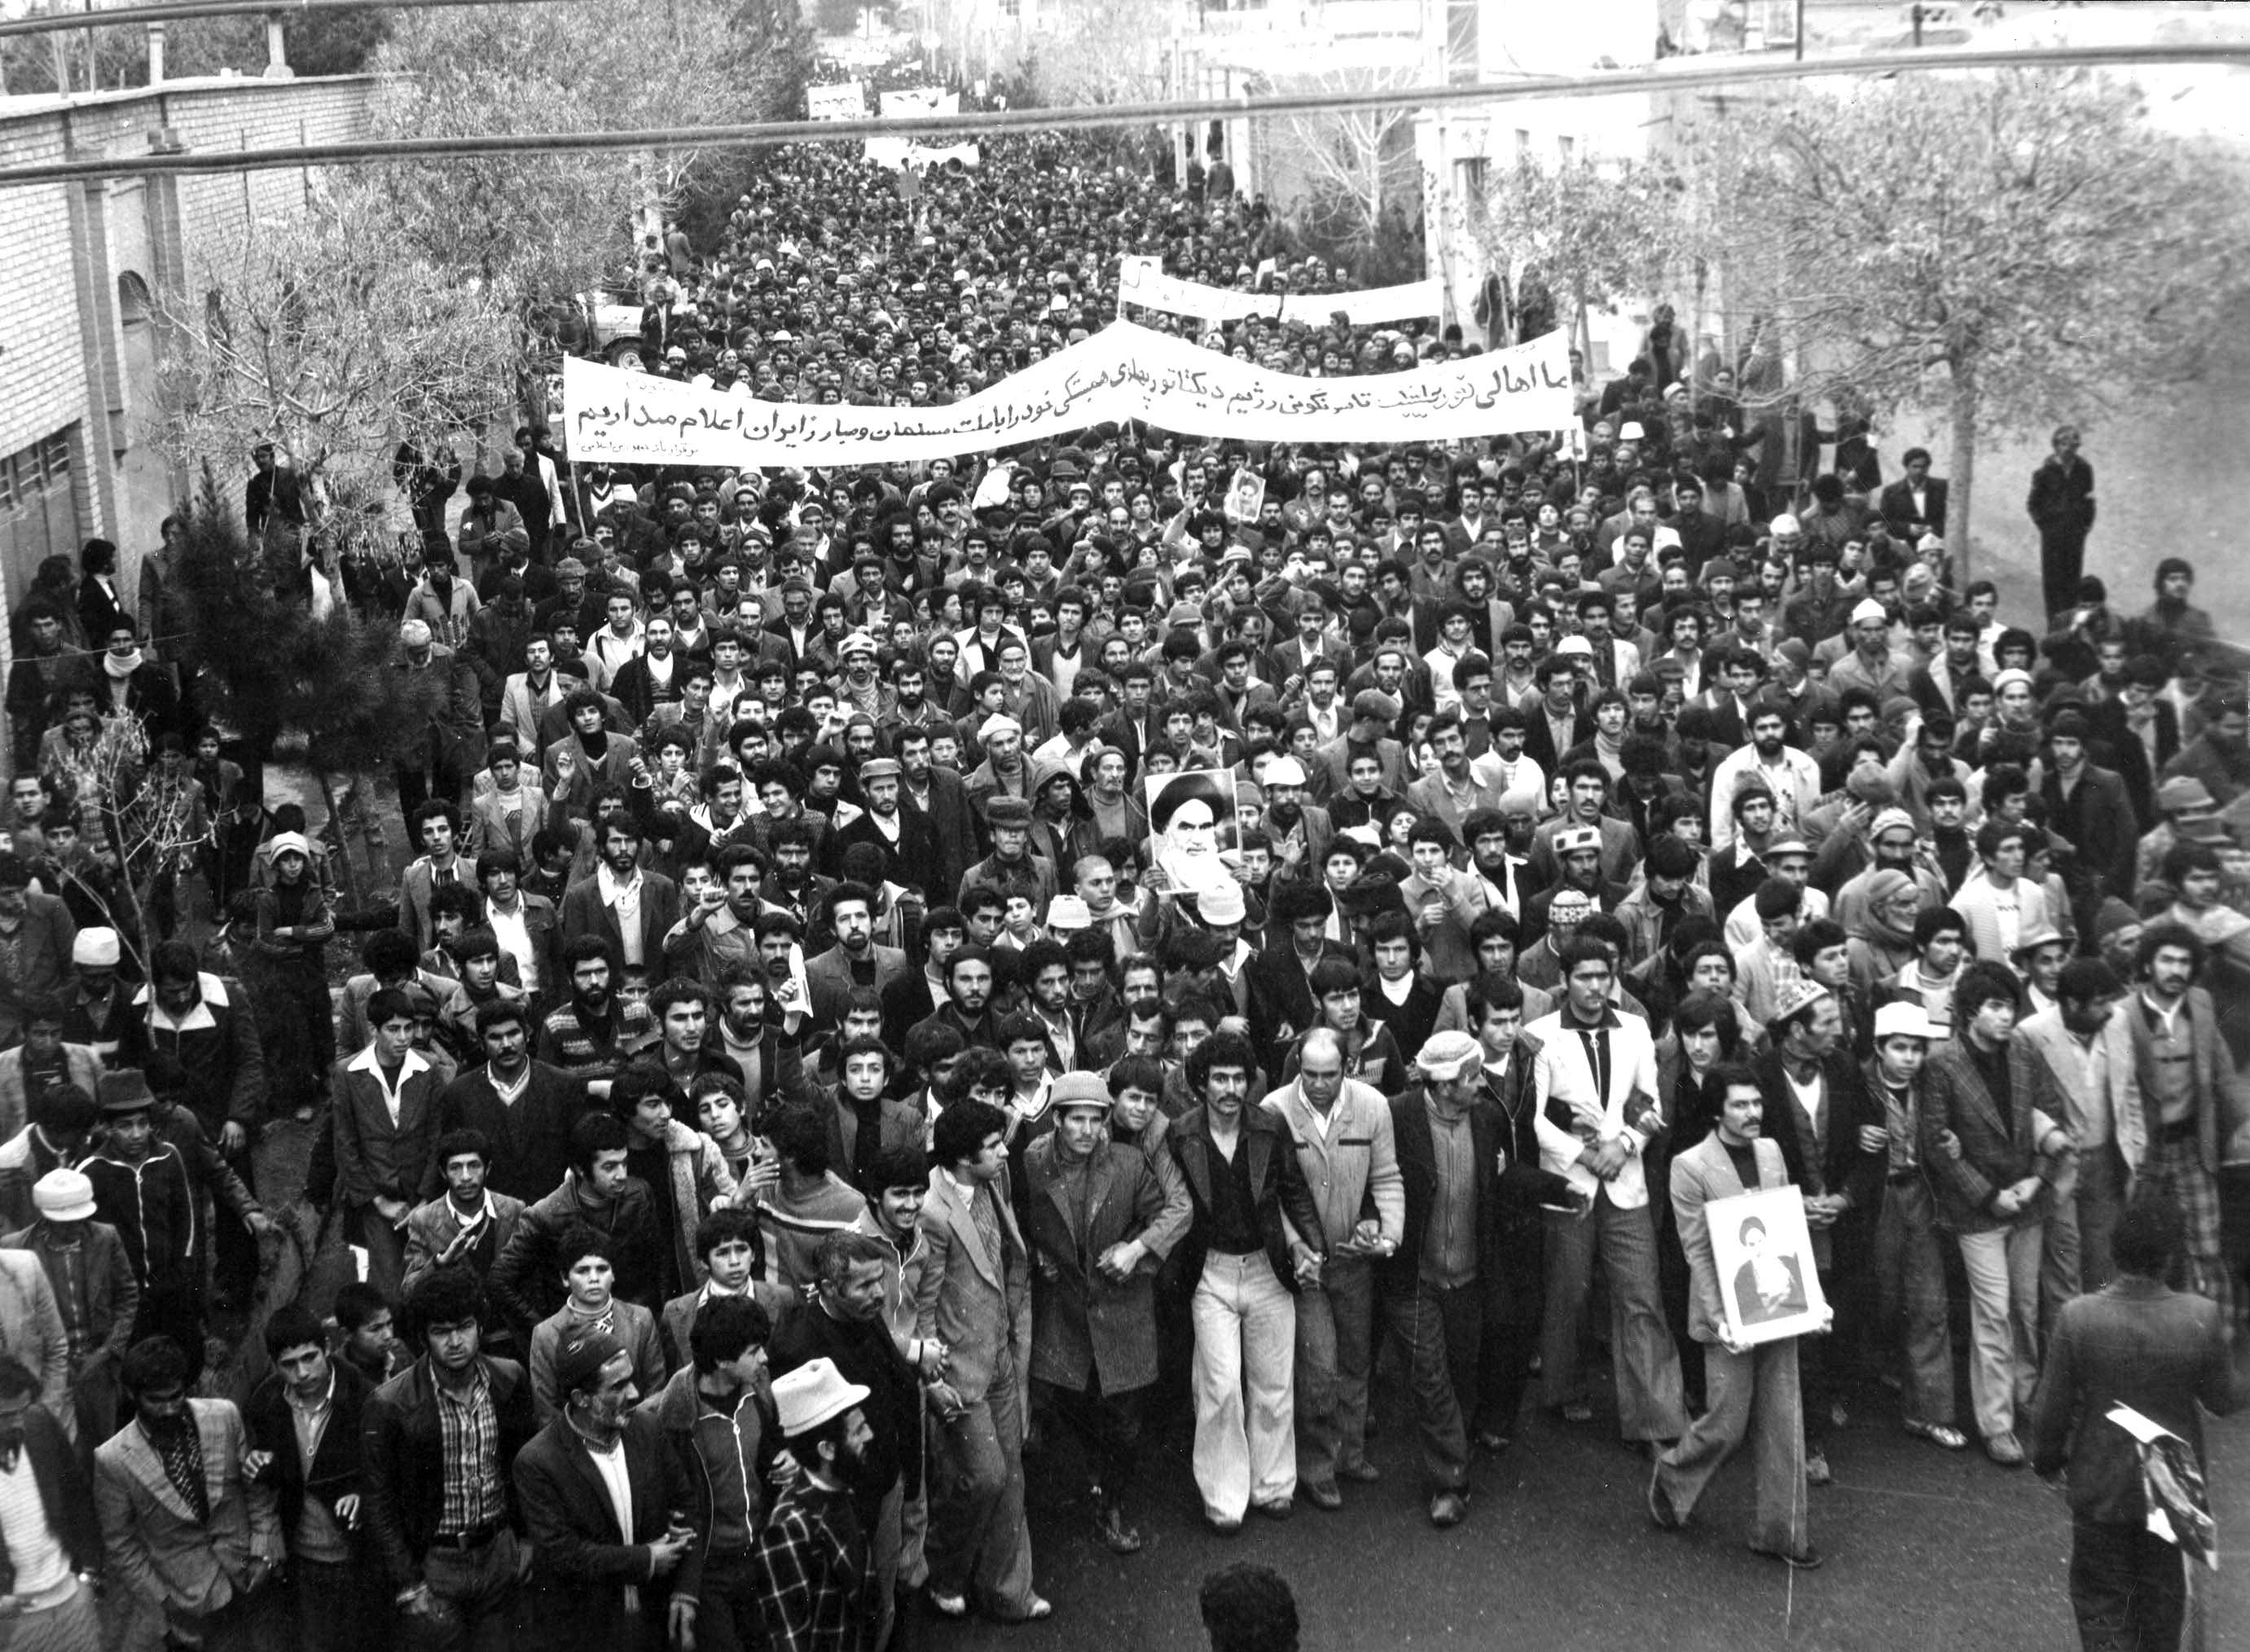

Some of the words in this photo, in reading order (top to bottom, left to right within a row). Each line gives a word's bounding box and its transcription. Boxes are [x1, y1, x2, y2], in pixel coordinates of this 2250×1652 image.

[1149, 368, 1224, 409] دیکتاتور
[1227, 381, 1277, 415] رژیم
[1475, 362, 1536, 410] اهالی
[680, 406, 744, 438] اعلام
[743, 408, 806, 448] ایران
[803, 415, 859, 445] مبارز
[869, 421, 950, 442] مسلمان
[952, 413, 993, 434] ملت
